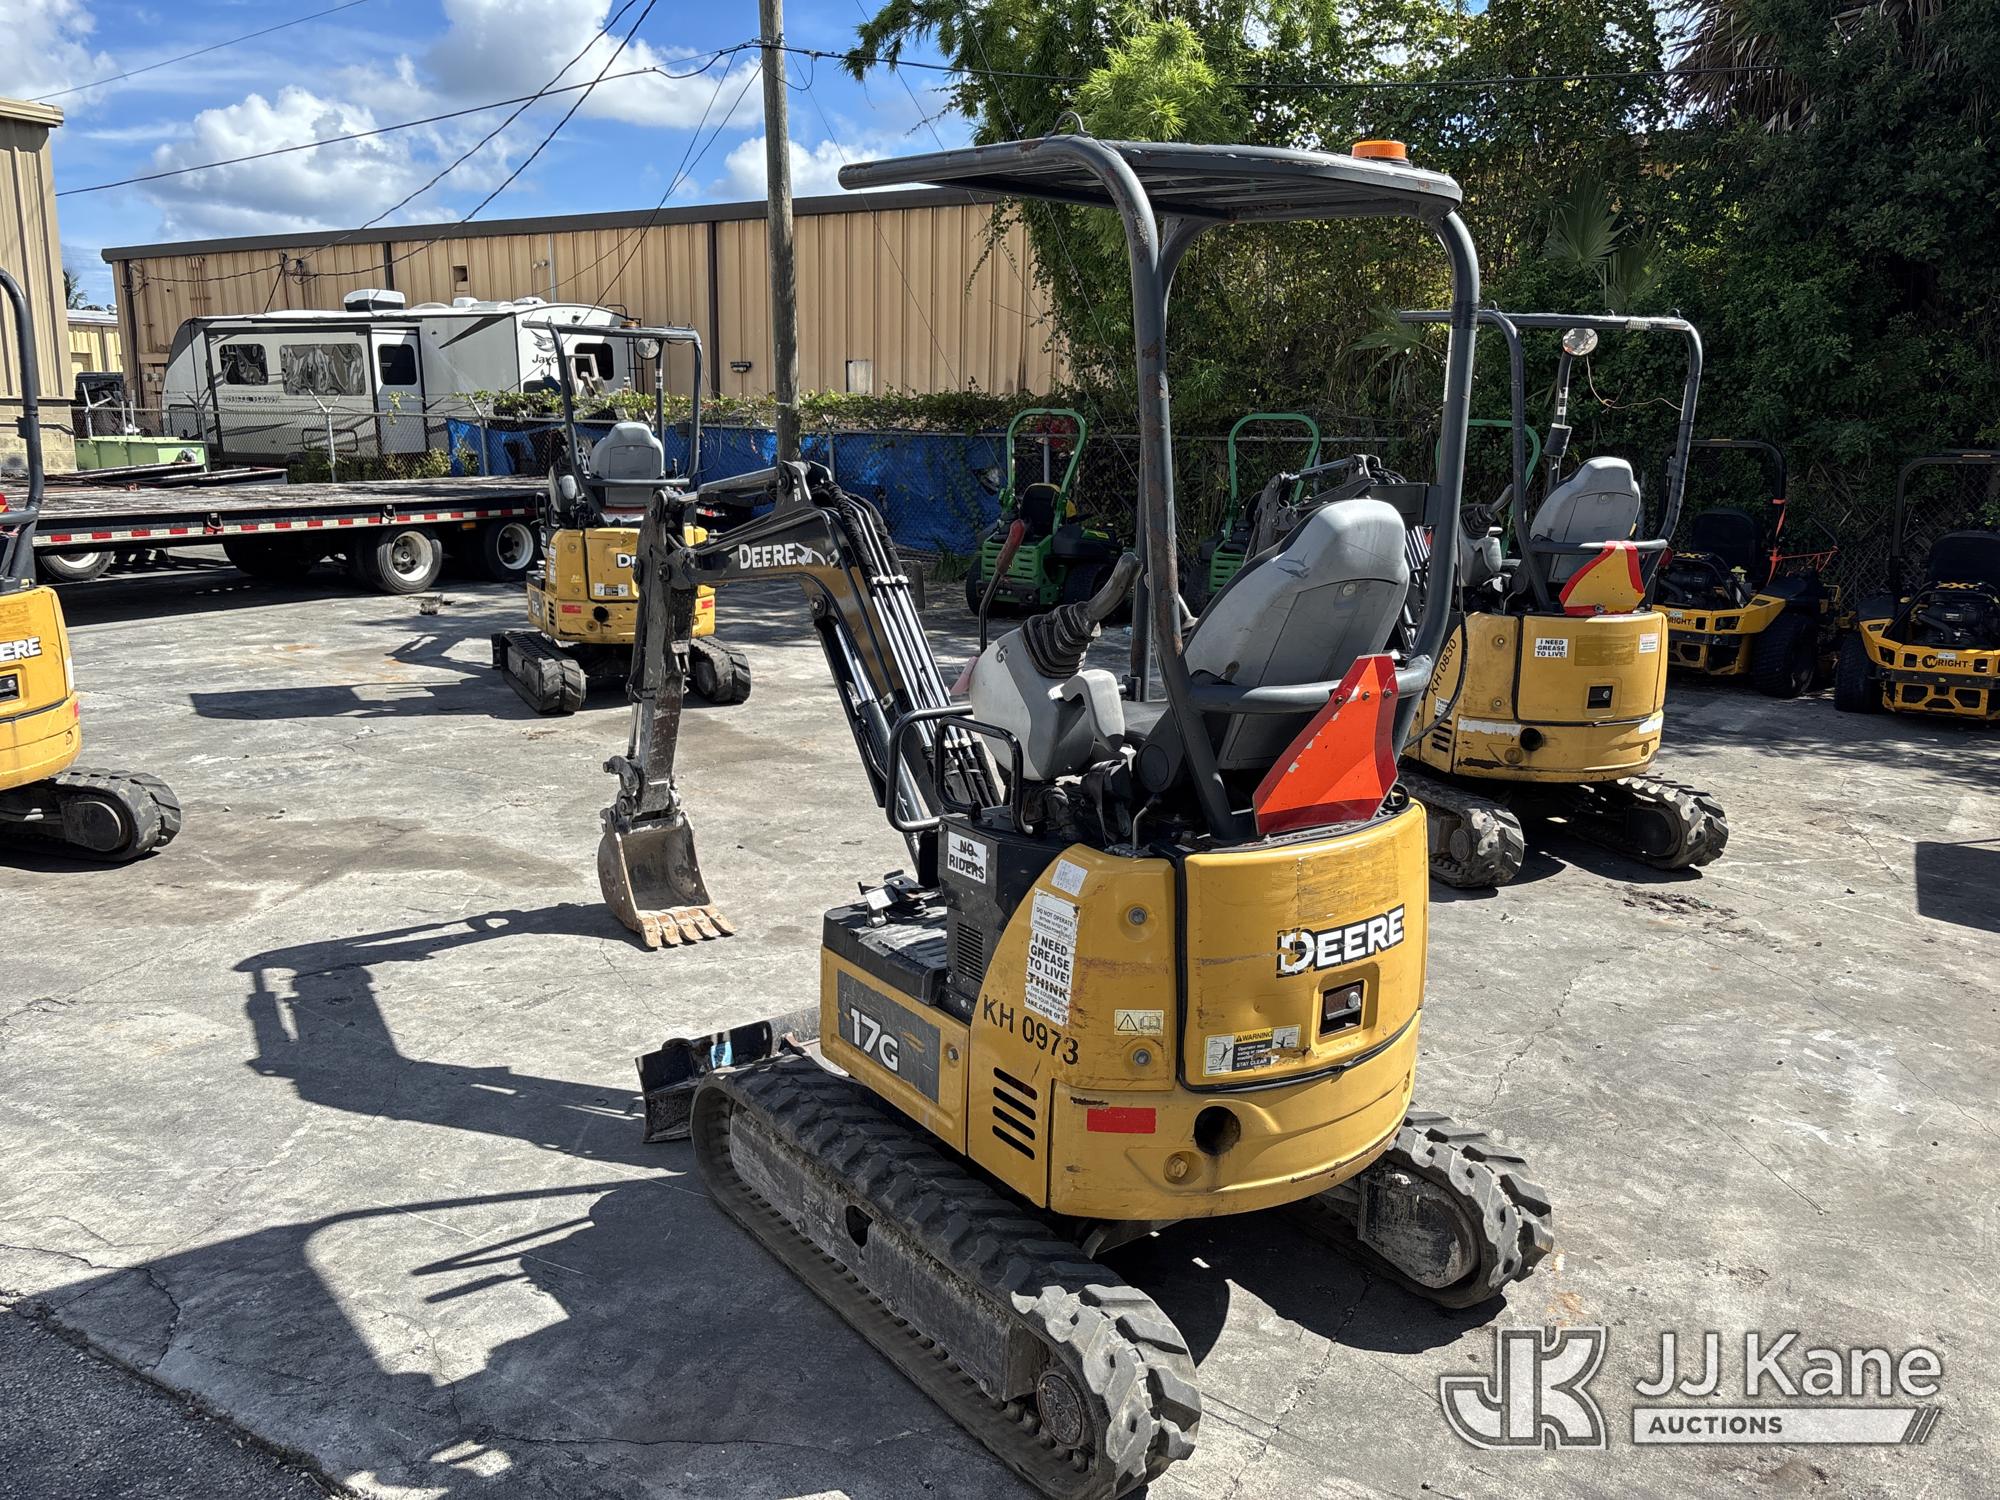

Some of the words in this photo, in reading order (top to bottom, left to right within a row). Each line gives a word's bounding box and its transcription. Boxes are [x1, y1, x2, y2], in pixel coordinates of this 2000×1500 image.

[532, 354, 559, 366] Jayc
[738, 542, 797, 570] DEERE
[1668, 616, 1692, 625] RIGHT
[0, 636, 42, 662] ERE
[1921, 655, 1968, 669] WRIGHT
[1430, 673, 1442, 696] KH
[1439, 638, 1457, 673] 0830
[959, 840, 976, 857] NO
[949, 854, 985, 880] RIDERS
[1041, 935, 1067, 956] NEED
[1278, 905, 1404, 976] DEERE
[1029, 956, 1042, 971] TO
[1044, 964, 1070, 985] LIVE!
[1030, 944, 1070, 971] GREASE
[1027, 972, 1067, 1001] THINK
[850, 1007, 899, 1072] 17G
[984, 994, 1014, 1033] KH
[1022, 1016, 1079, 1065] 0973
